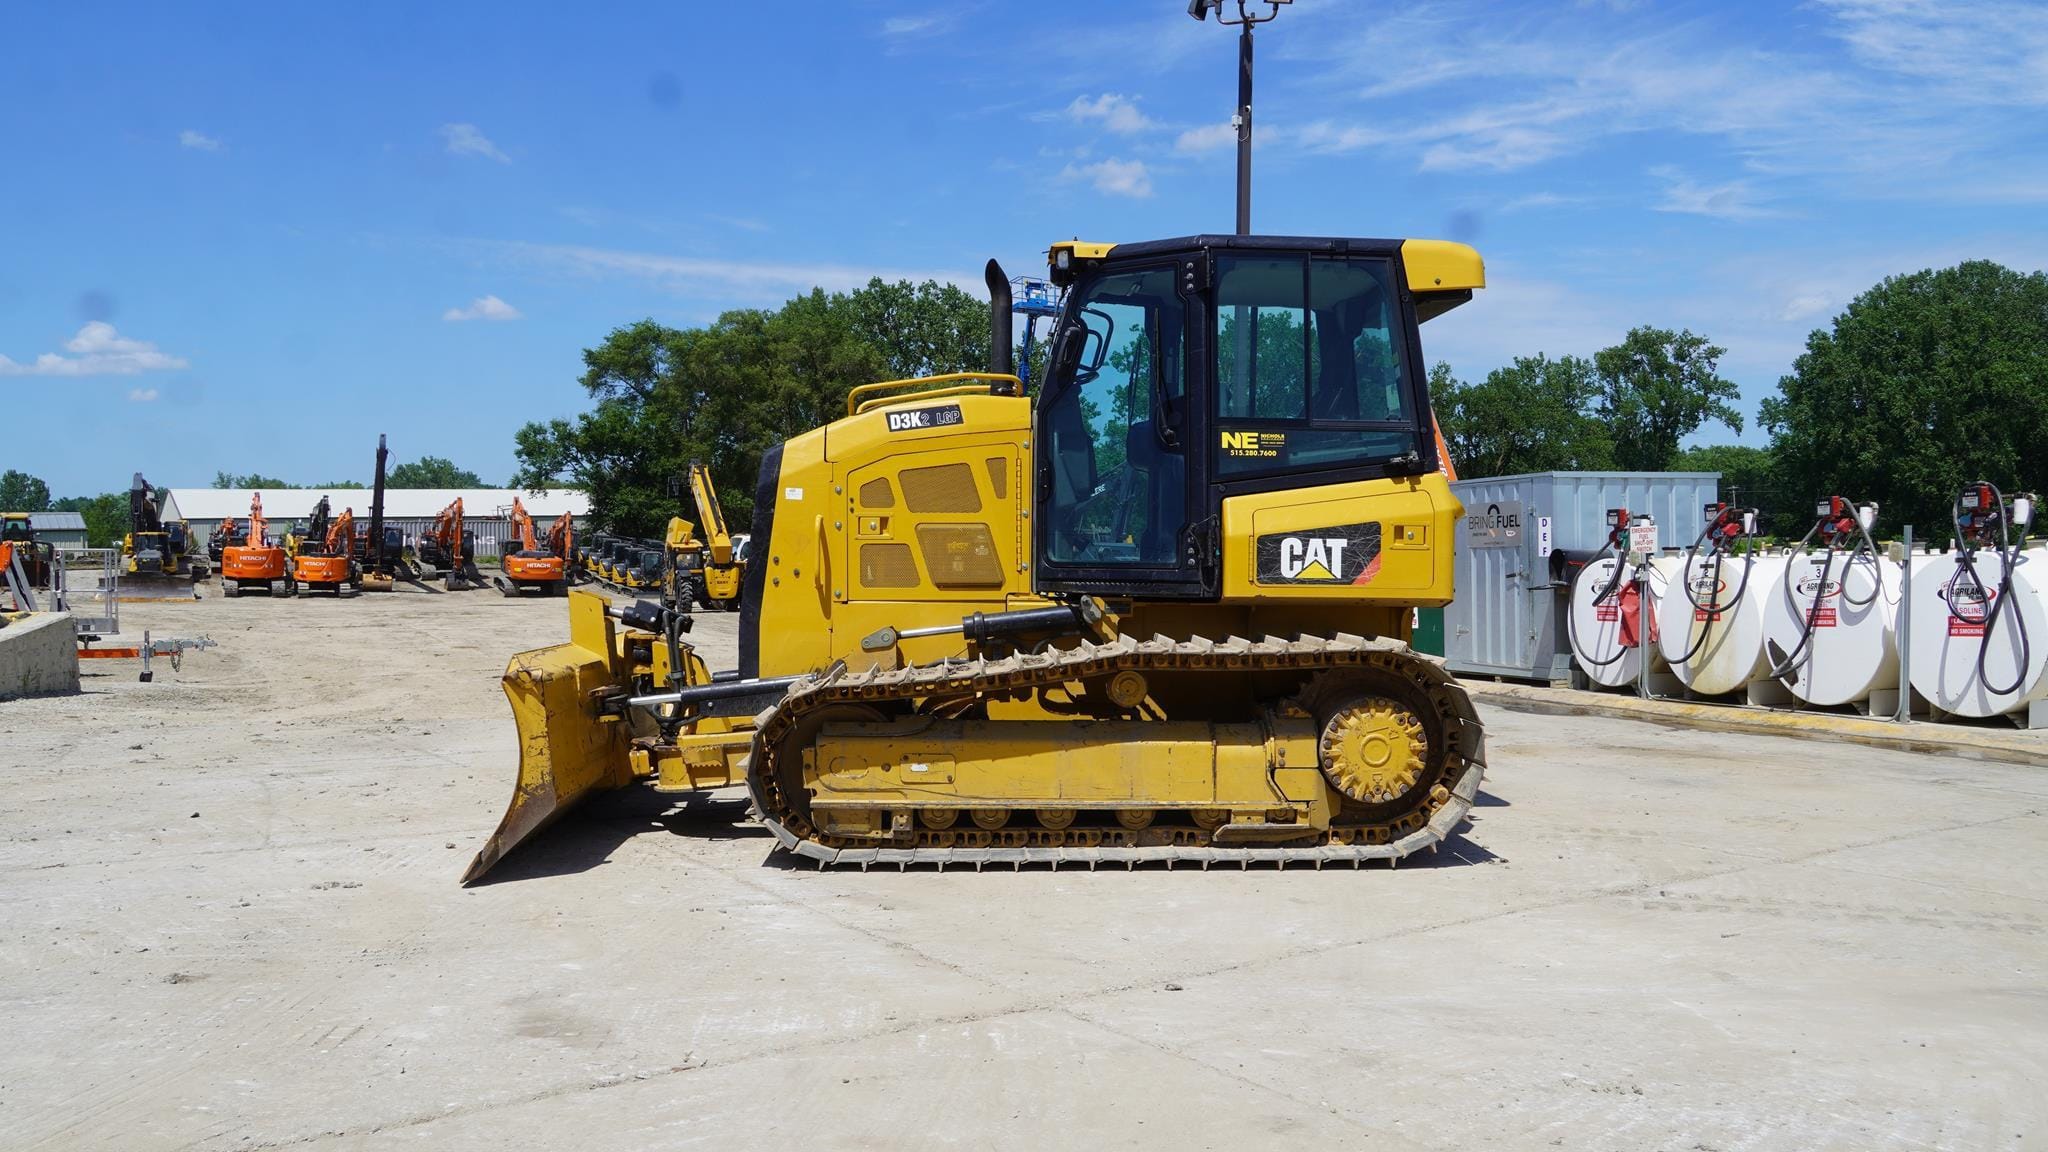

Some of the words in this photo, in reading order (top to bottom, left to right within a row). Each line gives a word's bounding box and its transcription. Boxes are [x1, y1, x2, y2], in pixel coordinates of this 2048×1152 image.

[889, 411, 930, 430] D3K2
[936, 410, 960, 425] LGP
[1221, 431, 1259, 449] NE
[1468, 515, 1495, 530] BRING
[1496, 514, 1520, 529] FUEL
[1281, 537, 1348, 579] CAT
[1703, 568, 1709, 577] 2
[1815, 568, 1822, 578] 3
